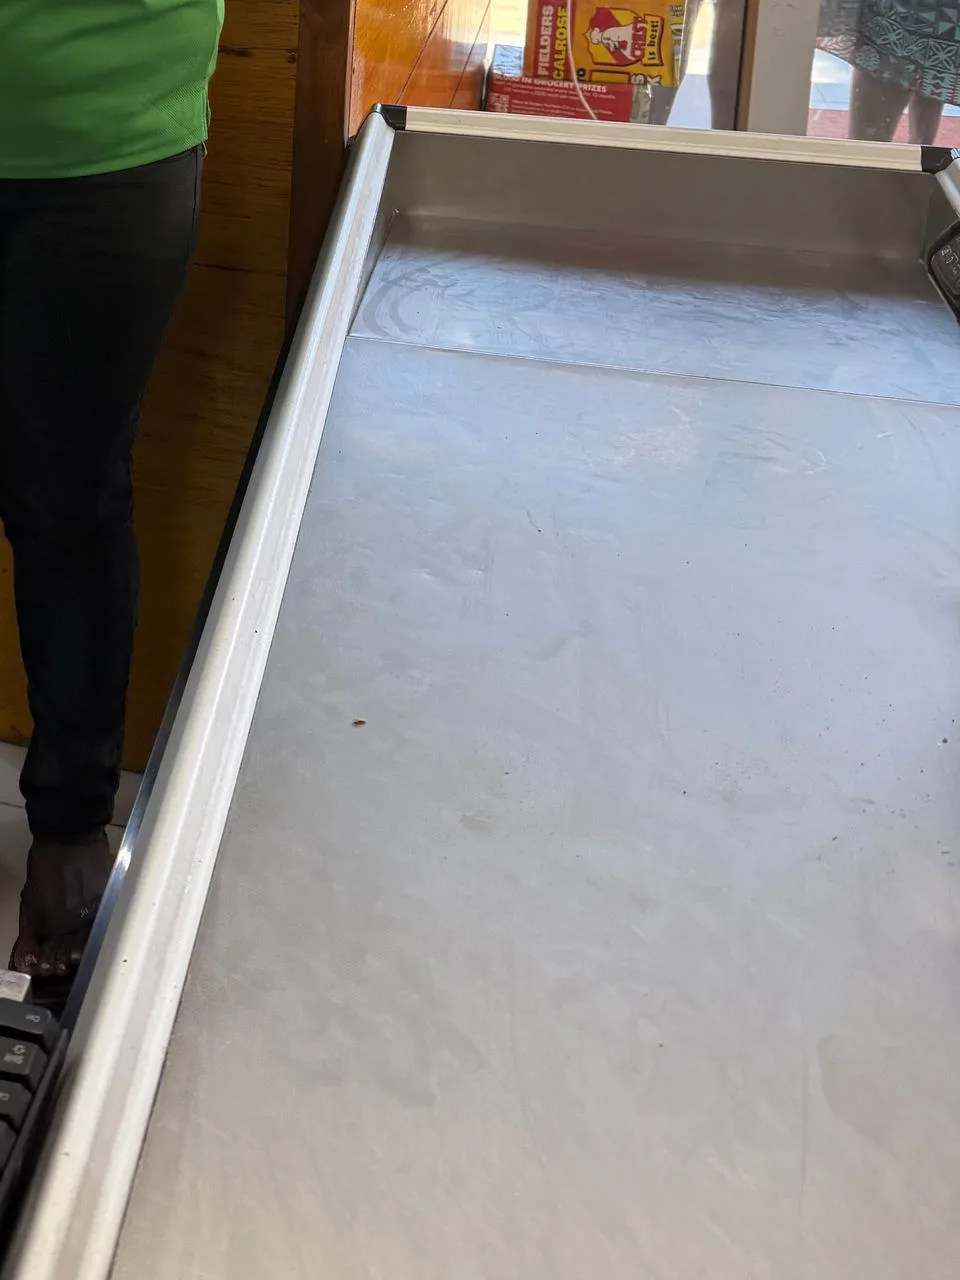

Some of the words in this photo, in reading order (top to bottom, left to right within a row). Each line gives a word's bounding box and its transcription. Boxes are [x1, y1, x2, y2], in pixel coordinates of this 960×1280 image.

[537, 5, 554, 76] FIELDERS
[553, 6, 568, 80] CALROSE
[534, 78, 574, 89] GROCERY
